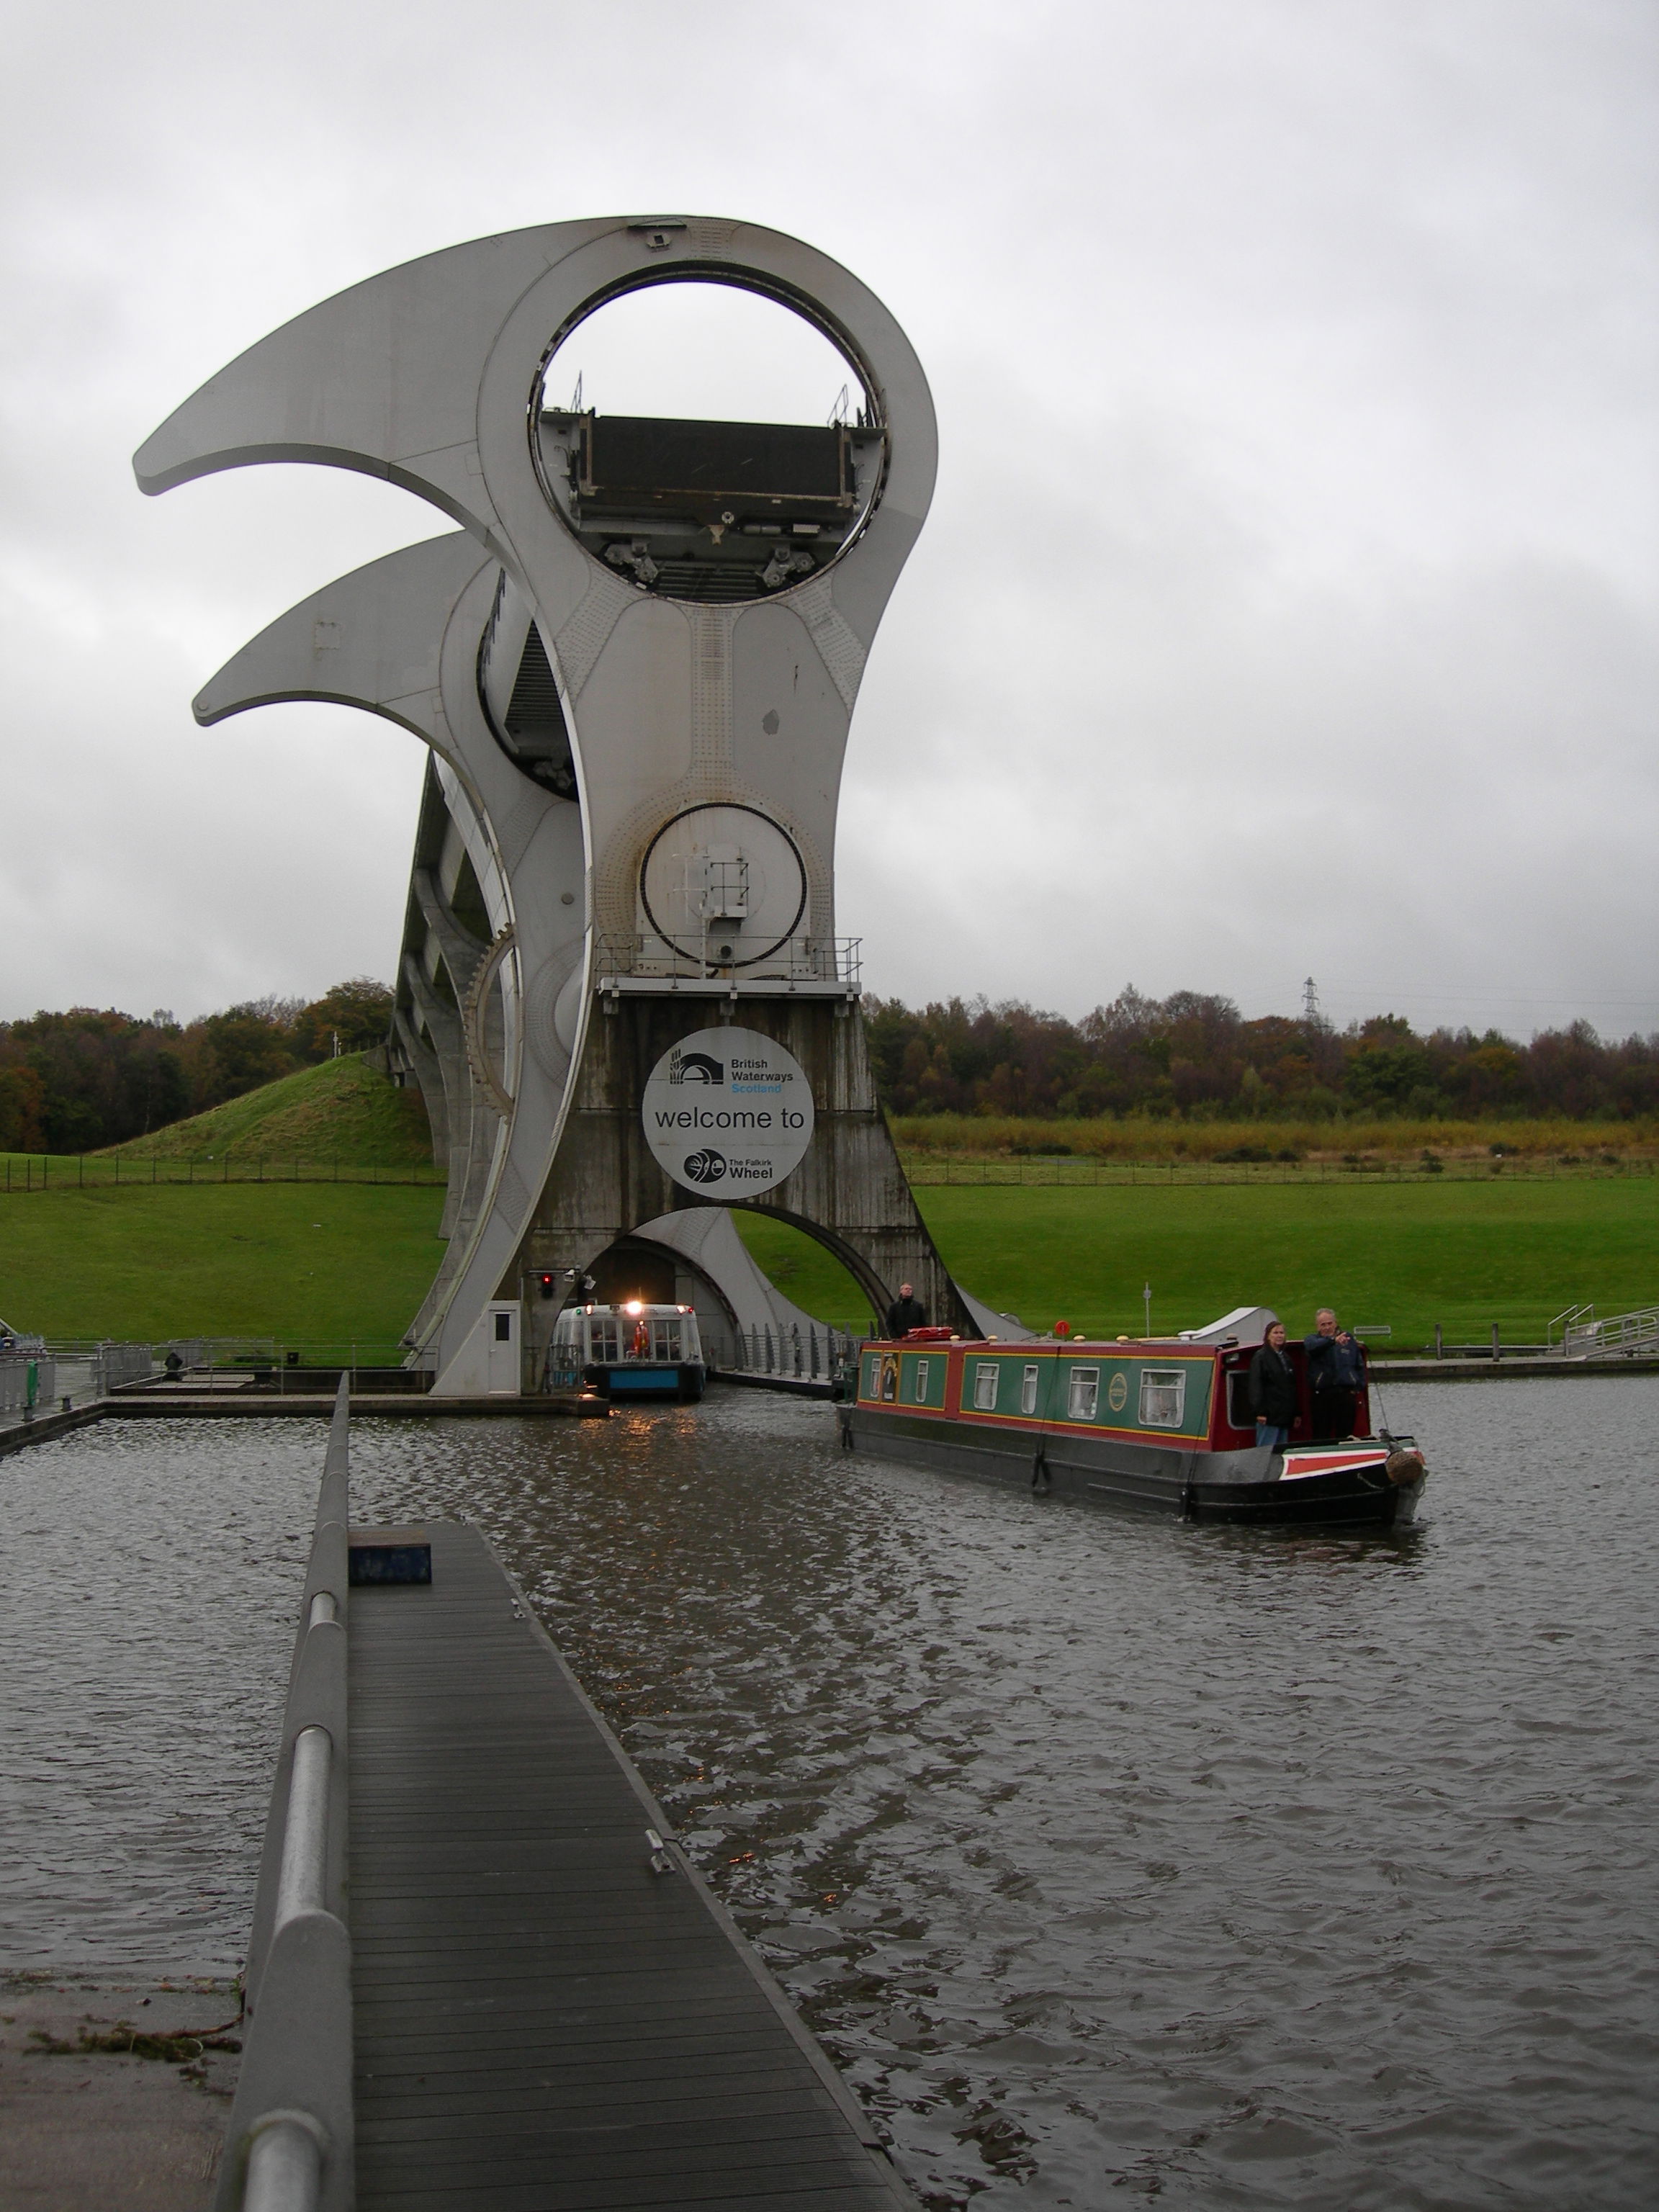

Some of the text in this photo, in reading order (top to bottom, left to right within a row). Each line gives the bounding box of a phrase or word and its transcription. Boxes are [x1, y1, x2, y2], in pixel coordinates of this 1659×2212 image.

[731, 1058, 768, 1069] British
[732, 1071, 793, 1083] Waterways
[732, 1083, 782, 1093] Scotland
[655, 1107, 804, 1128] welcome to
[729, 1166, 773, 1179] Wheel
